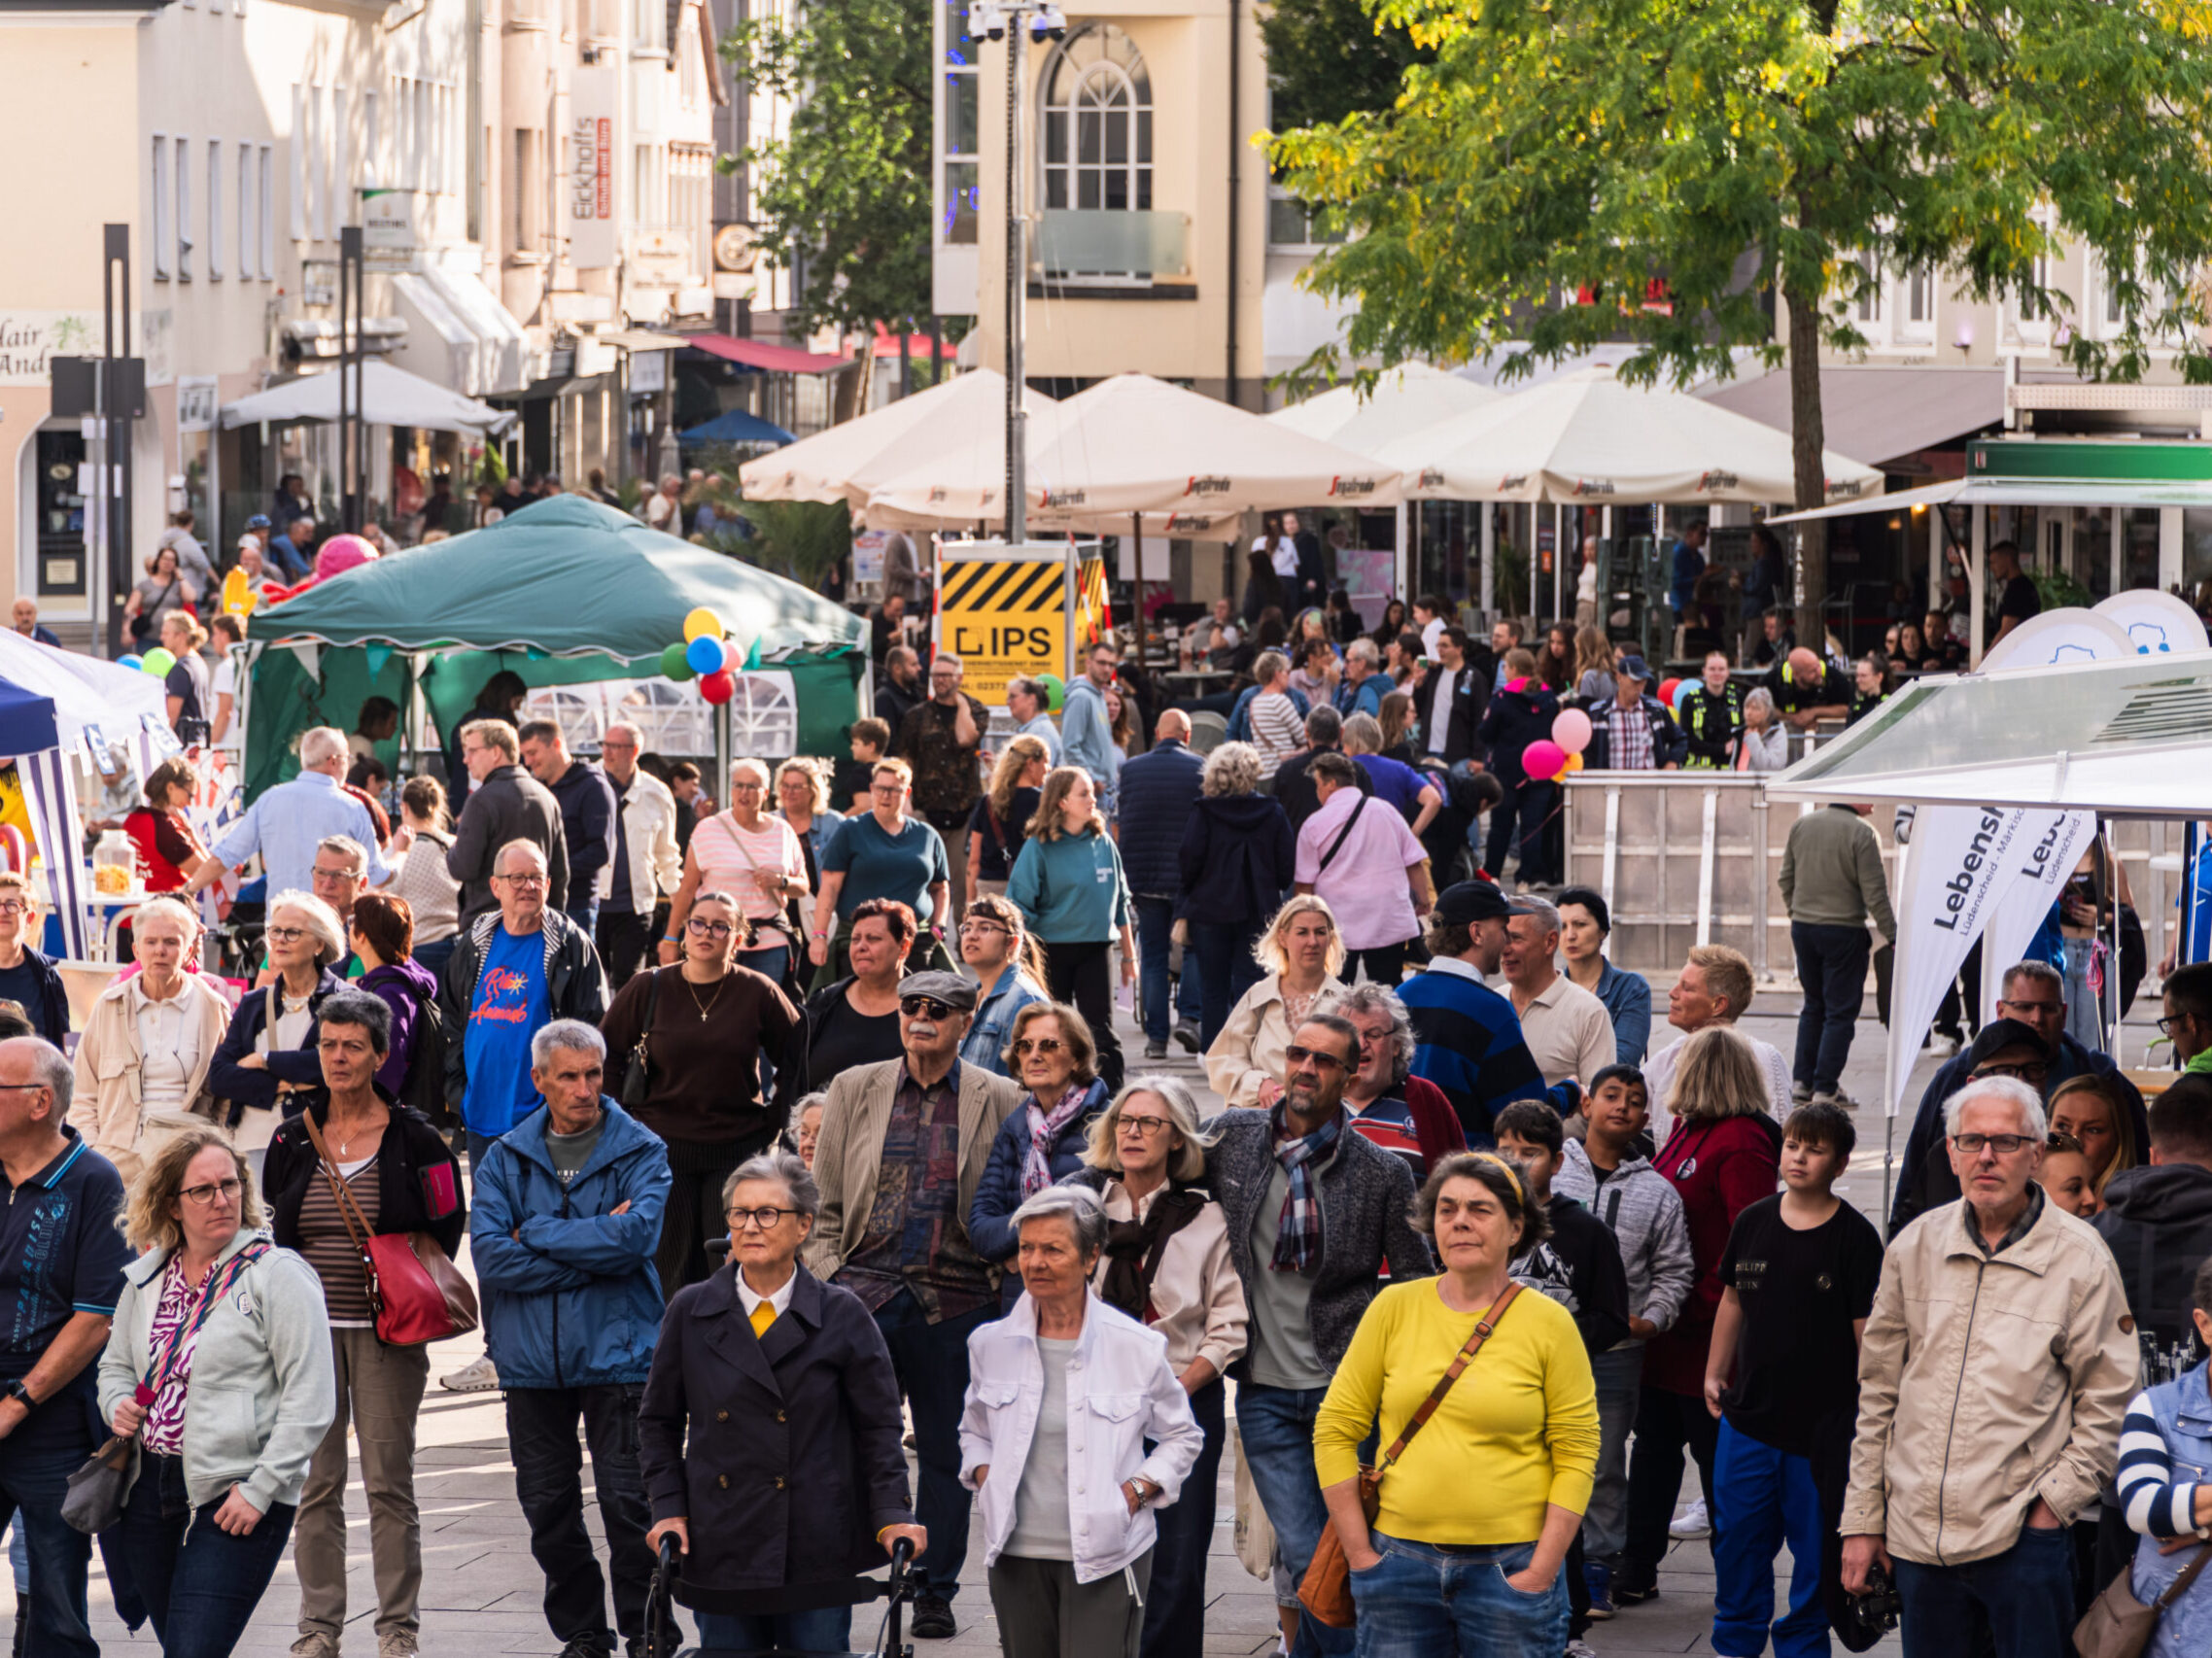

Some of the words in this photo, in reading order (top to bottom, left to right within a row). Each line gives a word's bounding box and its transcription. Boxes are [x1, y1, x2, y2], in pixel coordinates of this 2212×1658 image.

[990, 627, 1052, 657] IPS
[2044, 817, 2082, 885] Lüdenscheid
[1959, 861, 1998, 937] Lüdenscheid
